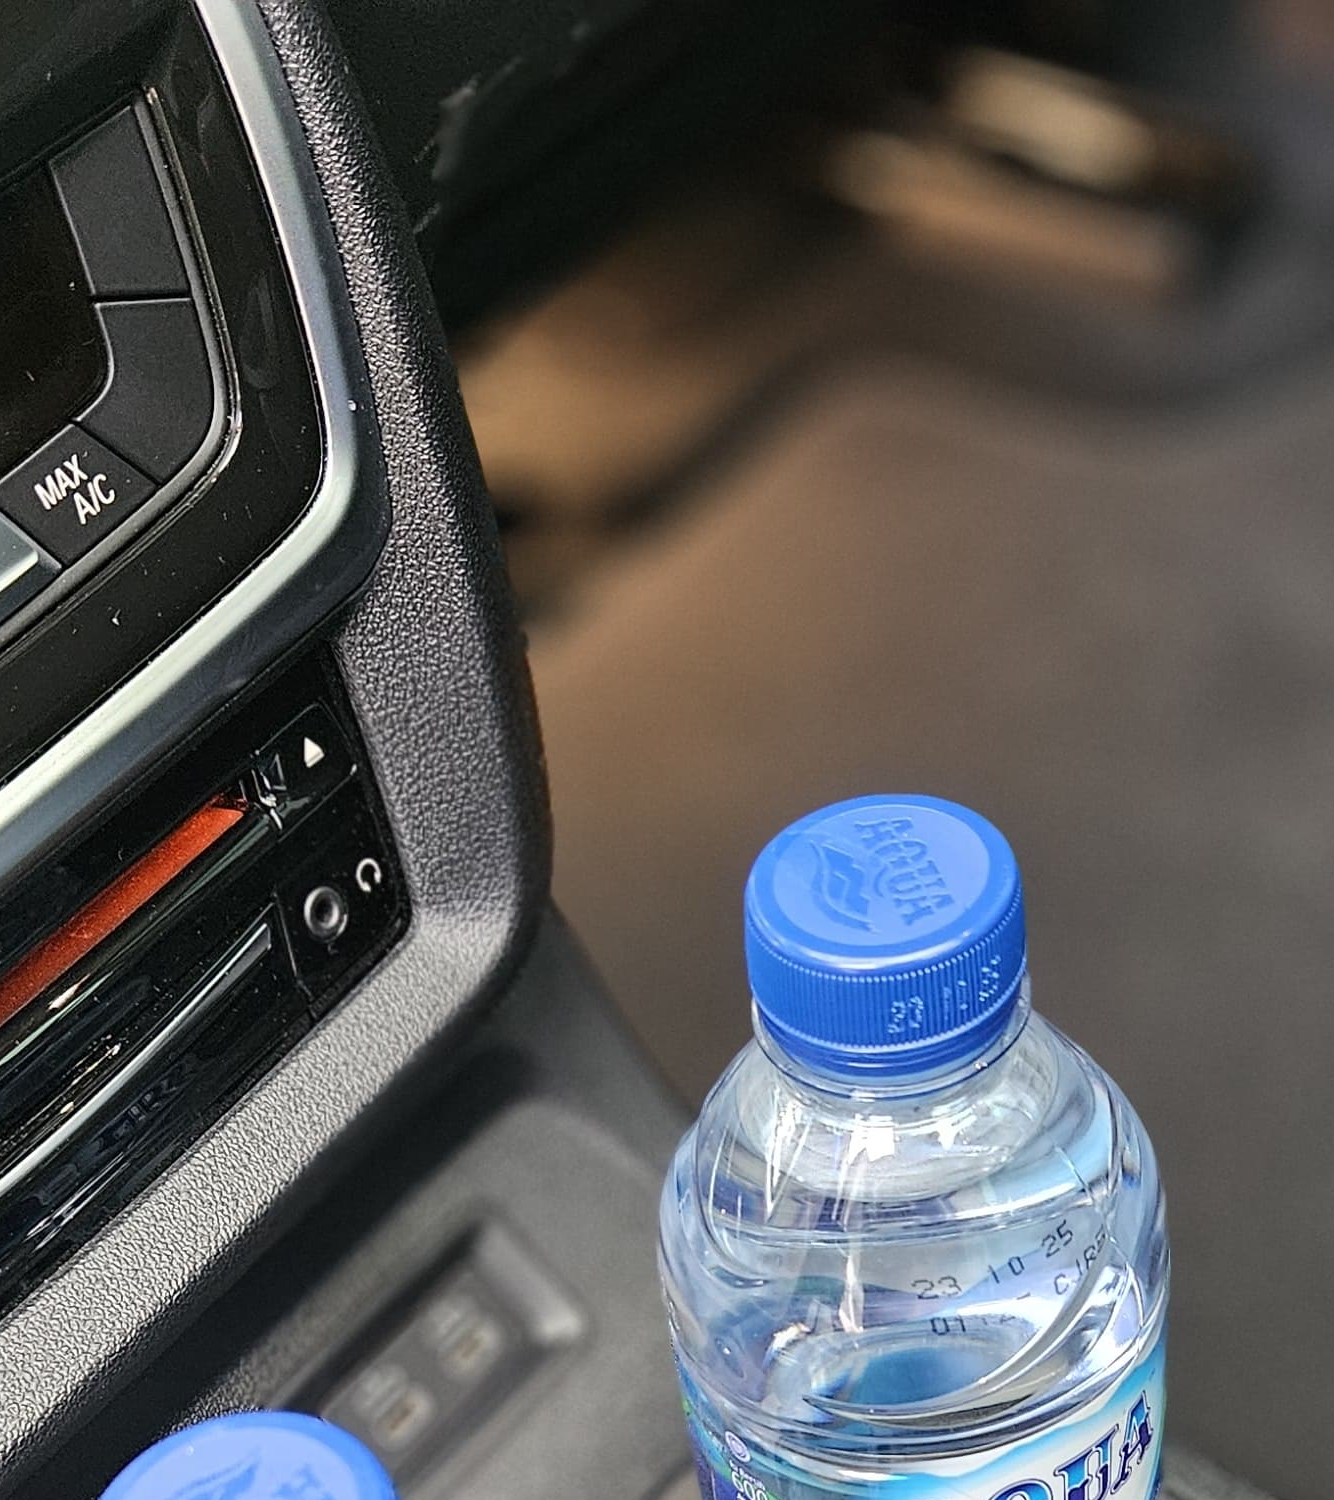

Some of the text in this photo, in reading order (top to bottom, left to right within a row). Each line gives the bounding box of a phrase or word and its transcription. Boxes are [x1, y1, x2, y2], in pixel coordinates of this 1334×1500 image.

[34, 454, 88, 510] MAX
[73, 473, 115, 525] A/C
[854, 816, 955, 926] AQUA
[911, 1219, 1074, 1300] 23 10 25
